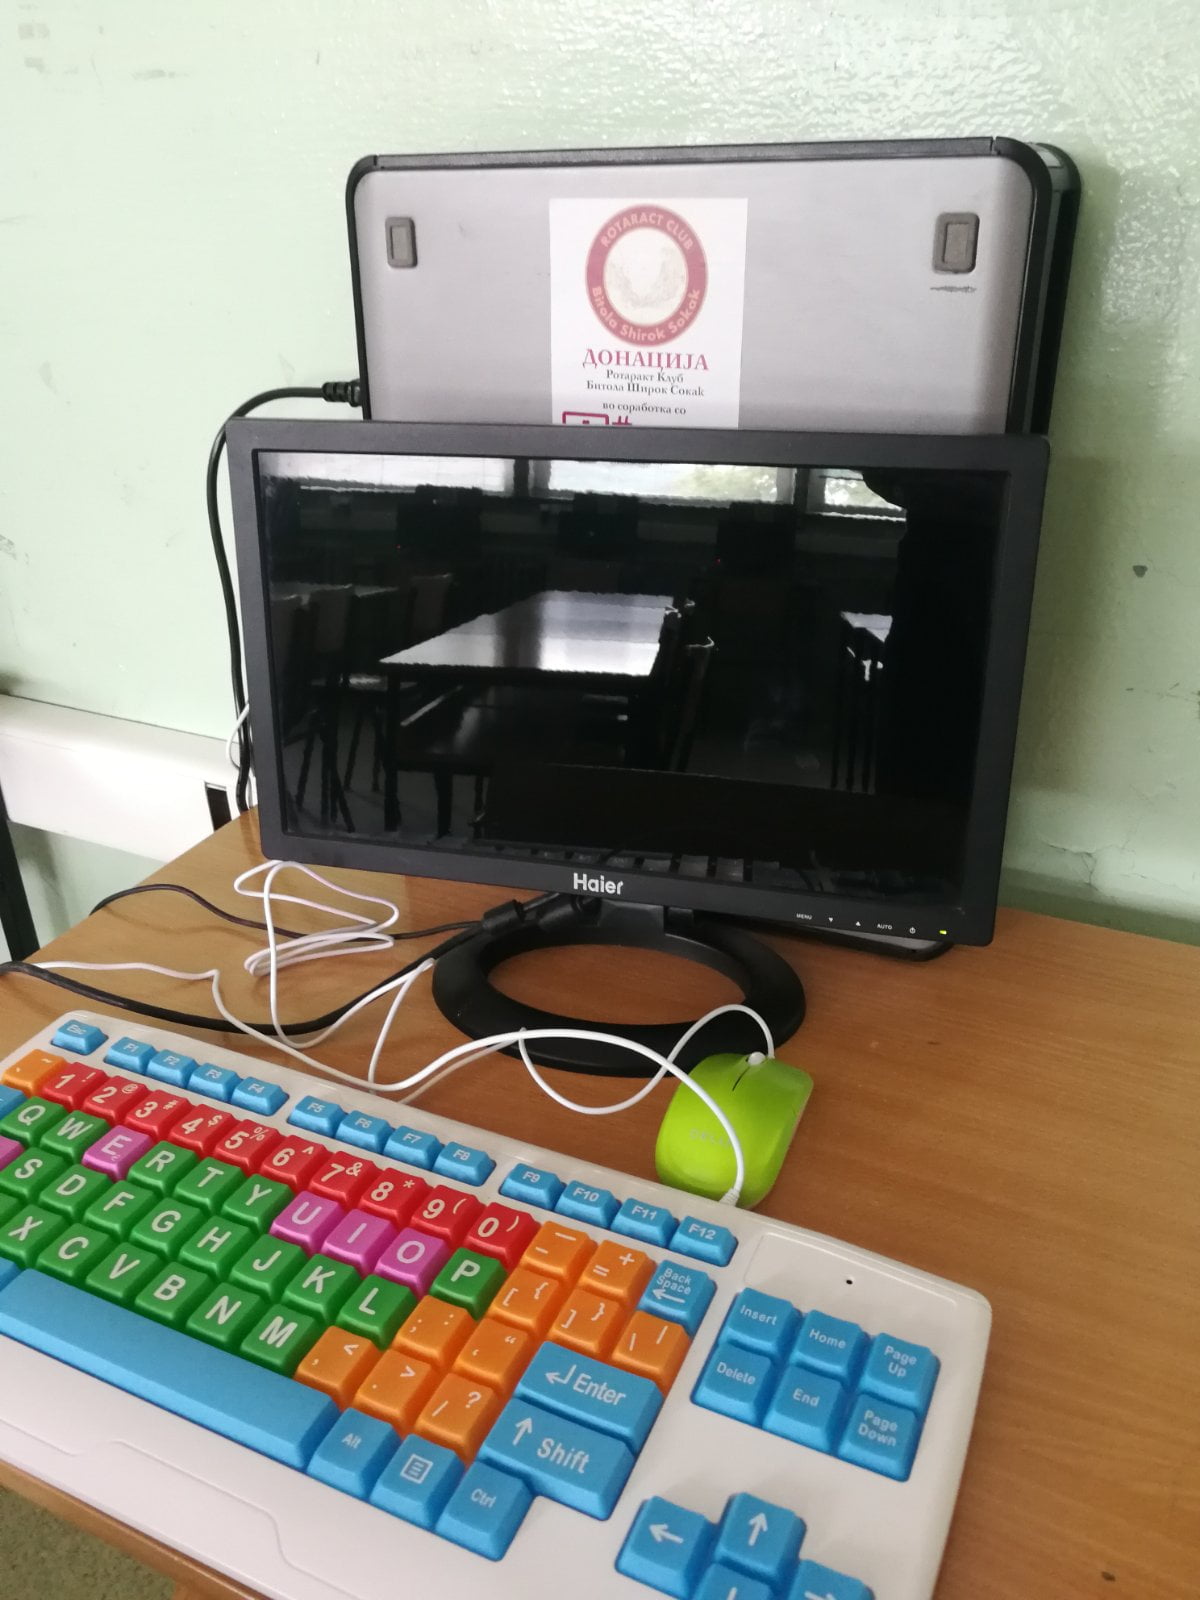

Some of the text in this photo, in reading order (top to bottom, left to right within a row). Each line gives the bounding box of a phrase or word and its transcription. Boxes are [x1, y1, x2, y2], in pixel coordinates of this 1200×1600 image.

[601, 212, 694, 251] ROTARACT CLUB
[592, 286, 701, 342] Bitola Shirok Sokak
[582, 348, 709, 372] ДОНАЦИЈА
[606, 369, 684, 384] Ротаракт Клуб
[587, 380, 704, 397] Битола Широк Сокак
[602, 402, 687, 415] во соработка со
[573, 872, 624, 895] Haier
[796, 912, 813, 920] MENU
[66, 1024, 88, 1035] Esc
[124, 1043, 137, 1053] F1
[164, 1056, 180, 1066] F2
[54, 1074, 76, 1088] 1
[205, 1069, 222, 1080] F3
[92, 1086, 117, 1103] 2
[248, 1083, 265, 1094] F4
[18, 1105, 46, 1126] Q
[135, 1101, 158, 1118] 3
[307, 1102, 324, 1113] F5
[56, 1117, 93, 1140] W
[181, 1117, 203, 1135] 4
[355, 1117, 370, 1129] F6
[101, 1134, 132, 1156] E
[224, 1131, 249, 1150] 5
[402, 1132, 422, 1144] F7
[145, 1150, 176, 1172] R
[272, 1148, 295, 1167] 6
[14, 1158, 43, 1179] S
[198, 1166, 224, 1187] T
[320, 1163, 345, 1182] 7
[522, 1171, 541, 1183] F9
[56, 1174, 87, 1196] D
[245, 1184, 272, 1206] Y
[371, 1181, 394, 1202] 8
[573, 1187, 600, 1202] F10
[103, 1191, 135, 1211] F
[422, 1199, 446, 1219] 9
[151, 1210, 182, 1233] G
[291, 1201, 322, 1225] U
[631, 1205, 658, 1221] F11
[8, 1216, 44, 1241] X
[477, 1217, 500, 1238] 0
[688, 1223, 717, 1240] F12
[57, 1236, 89, 1260] C
[197, 1226, 232, 1252] H
[252, 1250, 282, 1271] J
[396, 1240, 426, 1264] O
[109, 1253, 141, 1279] V
[451, 1259, 481, 1282] P
[153, 1274, 186, 1301] B
[301, 1265, 336, 1294] K
[656, 1277, 692, 1296] Space
[664, 1268, 692, 1286] Back
[204, 1295, 242, 1325] N
[358, 1287, 379, 1316] L
[740, 1304, 778, 1326] Insert
[259, 1316, 298, 1348] M
[809, 1328, 847, 1349] Home
[884, 1345, 917, 1366] Page
[716, 1361, 756, 1385] Delete
[888, 1362, 907, 1378] Up
[573, 1372, 627, 1407] Enter
[793, 1388, 820, 1408] End
[864, 1410, 898, 1432] Page
[341, 1433, 362, 1449] Alt
[858, 1424, 897, 1447] Down
[537, 1437, 590, 1474] Shift
[471, 1488, 496, 1508] Ctrl
